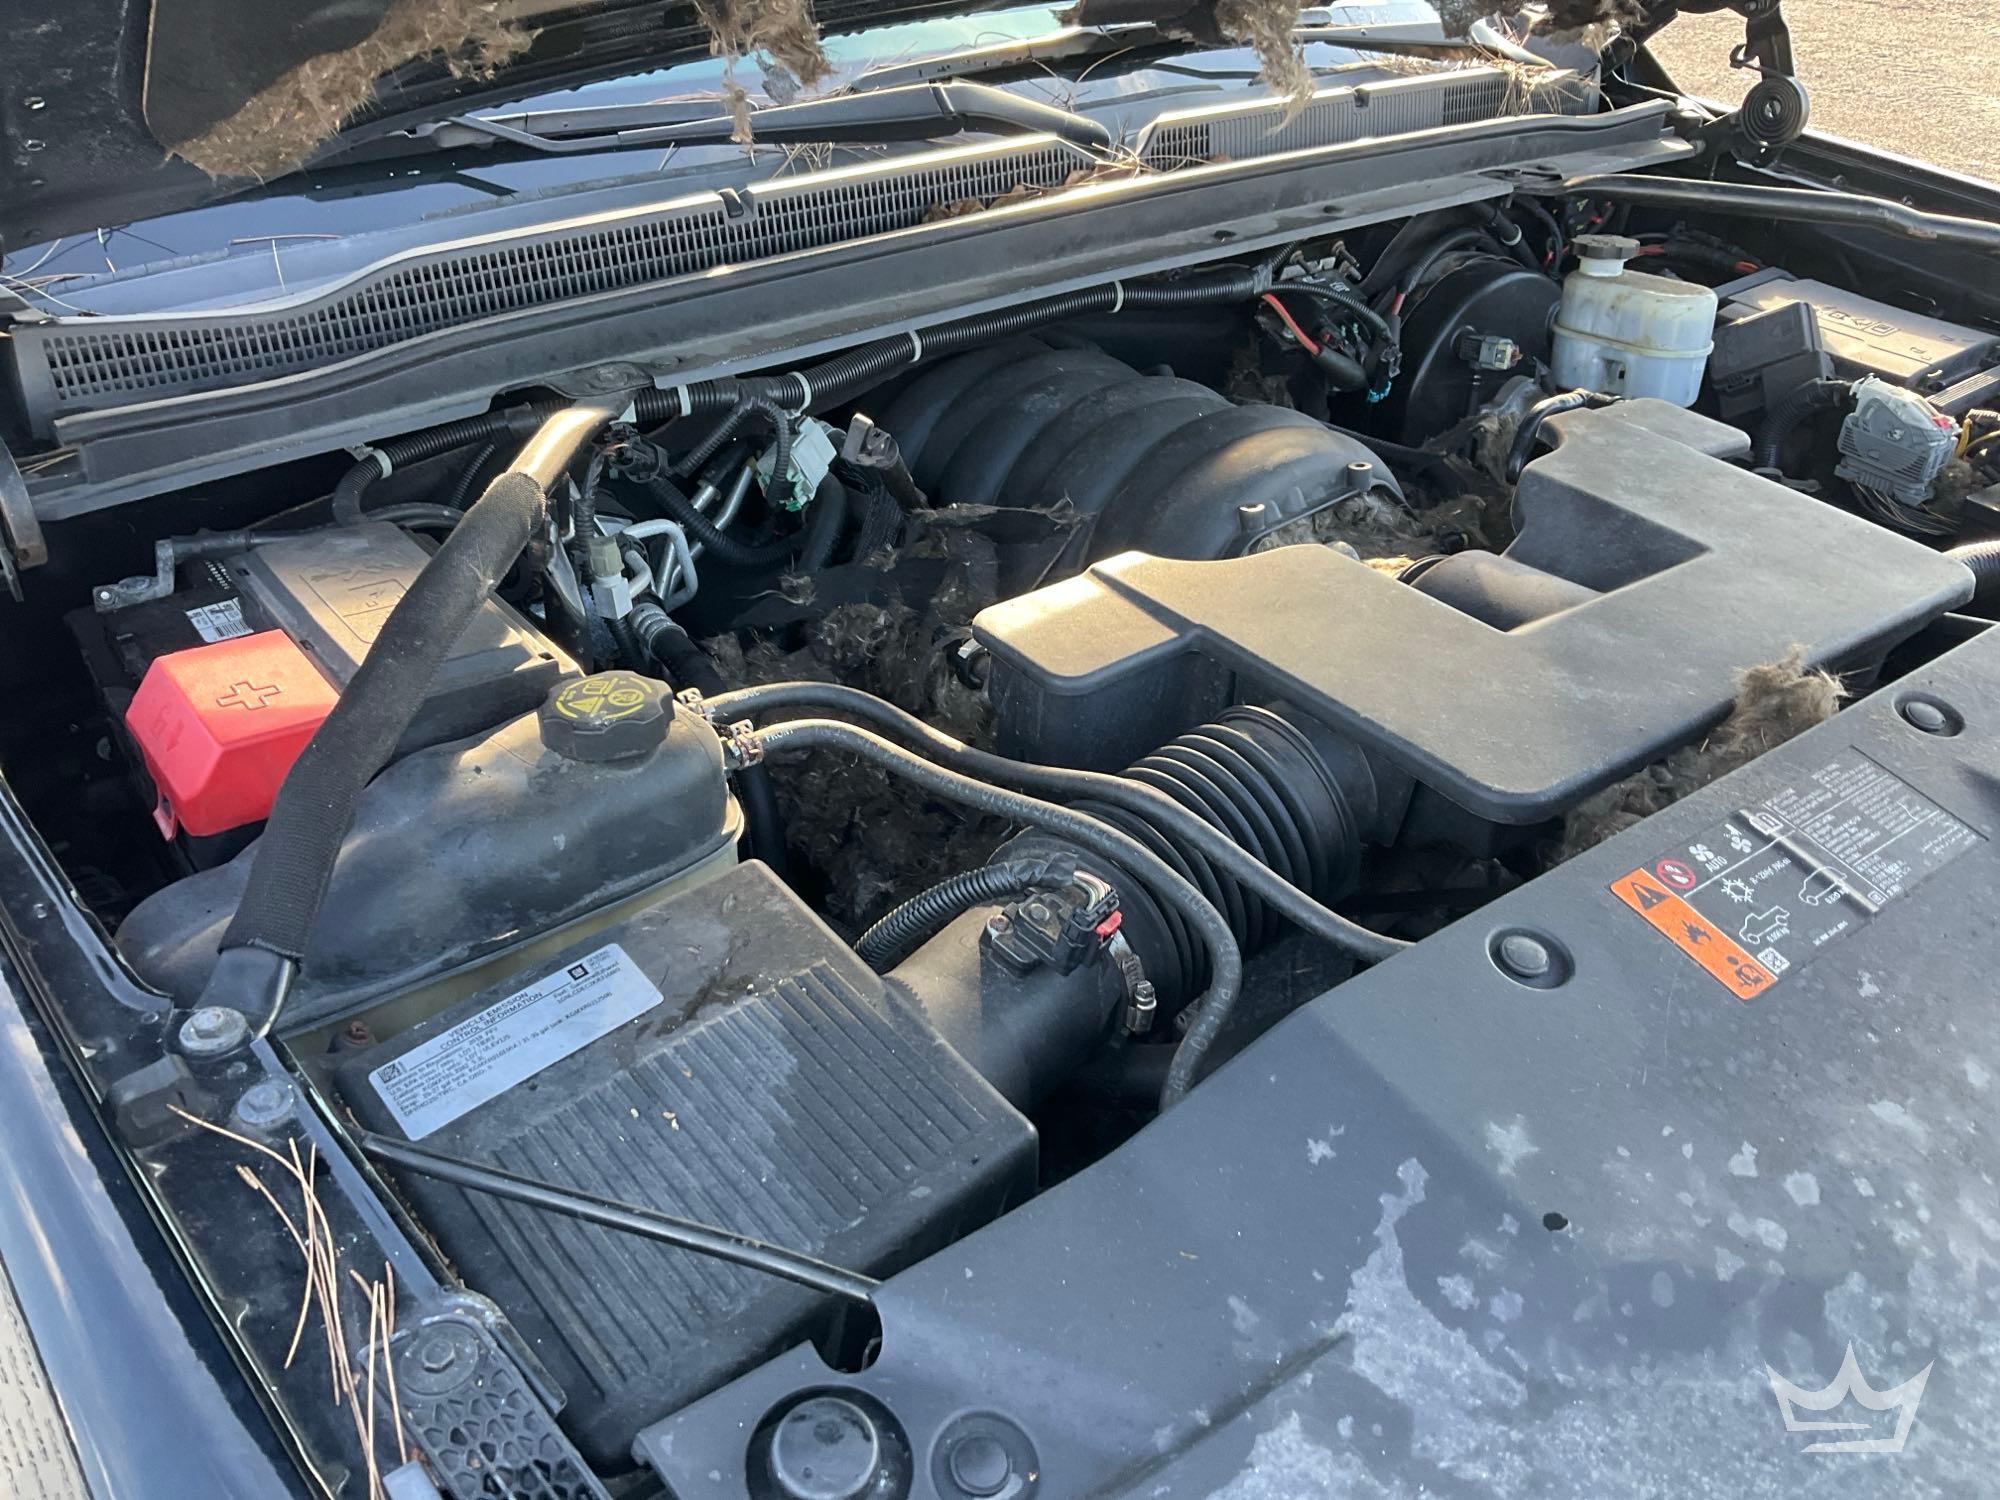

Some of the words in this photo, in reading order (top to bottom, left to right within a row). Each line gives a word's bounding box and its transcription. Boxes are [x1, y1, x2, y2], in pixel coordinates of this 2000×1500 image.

[765, 728, 795, 743] FRONT
[1704, 855, 1728, 872] AUTO
[440, 1024, 482, 1049] CONTROL
[483, 992, 541, 1025] INFORMATION
[448, 1015, 485, 1037] VEHICLE
[486, 992, 528, 1016] EMISSION
